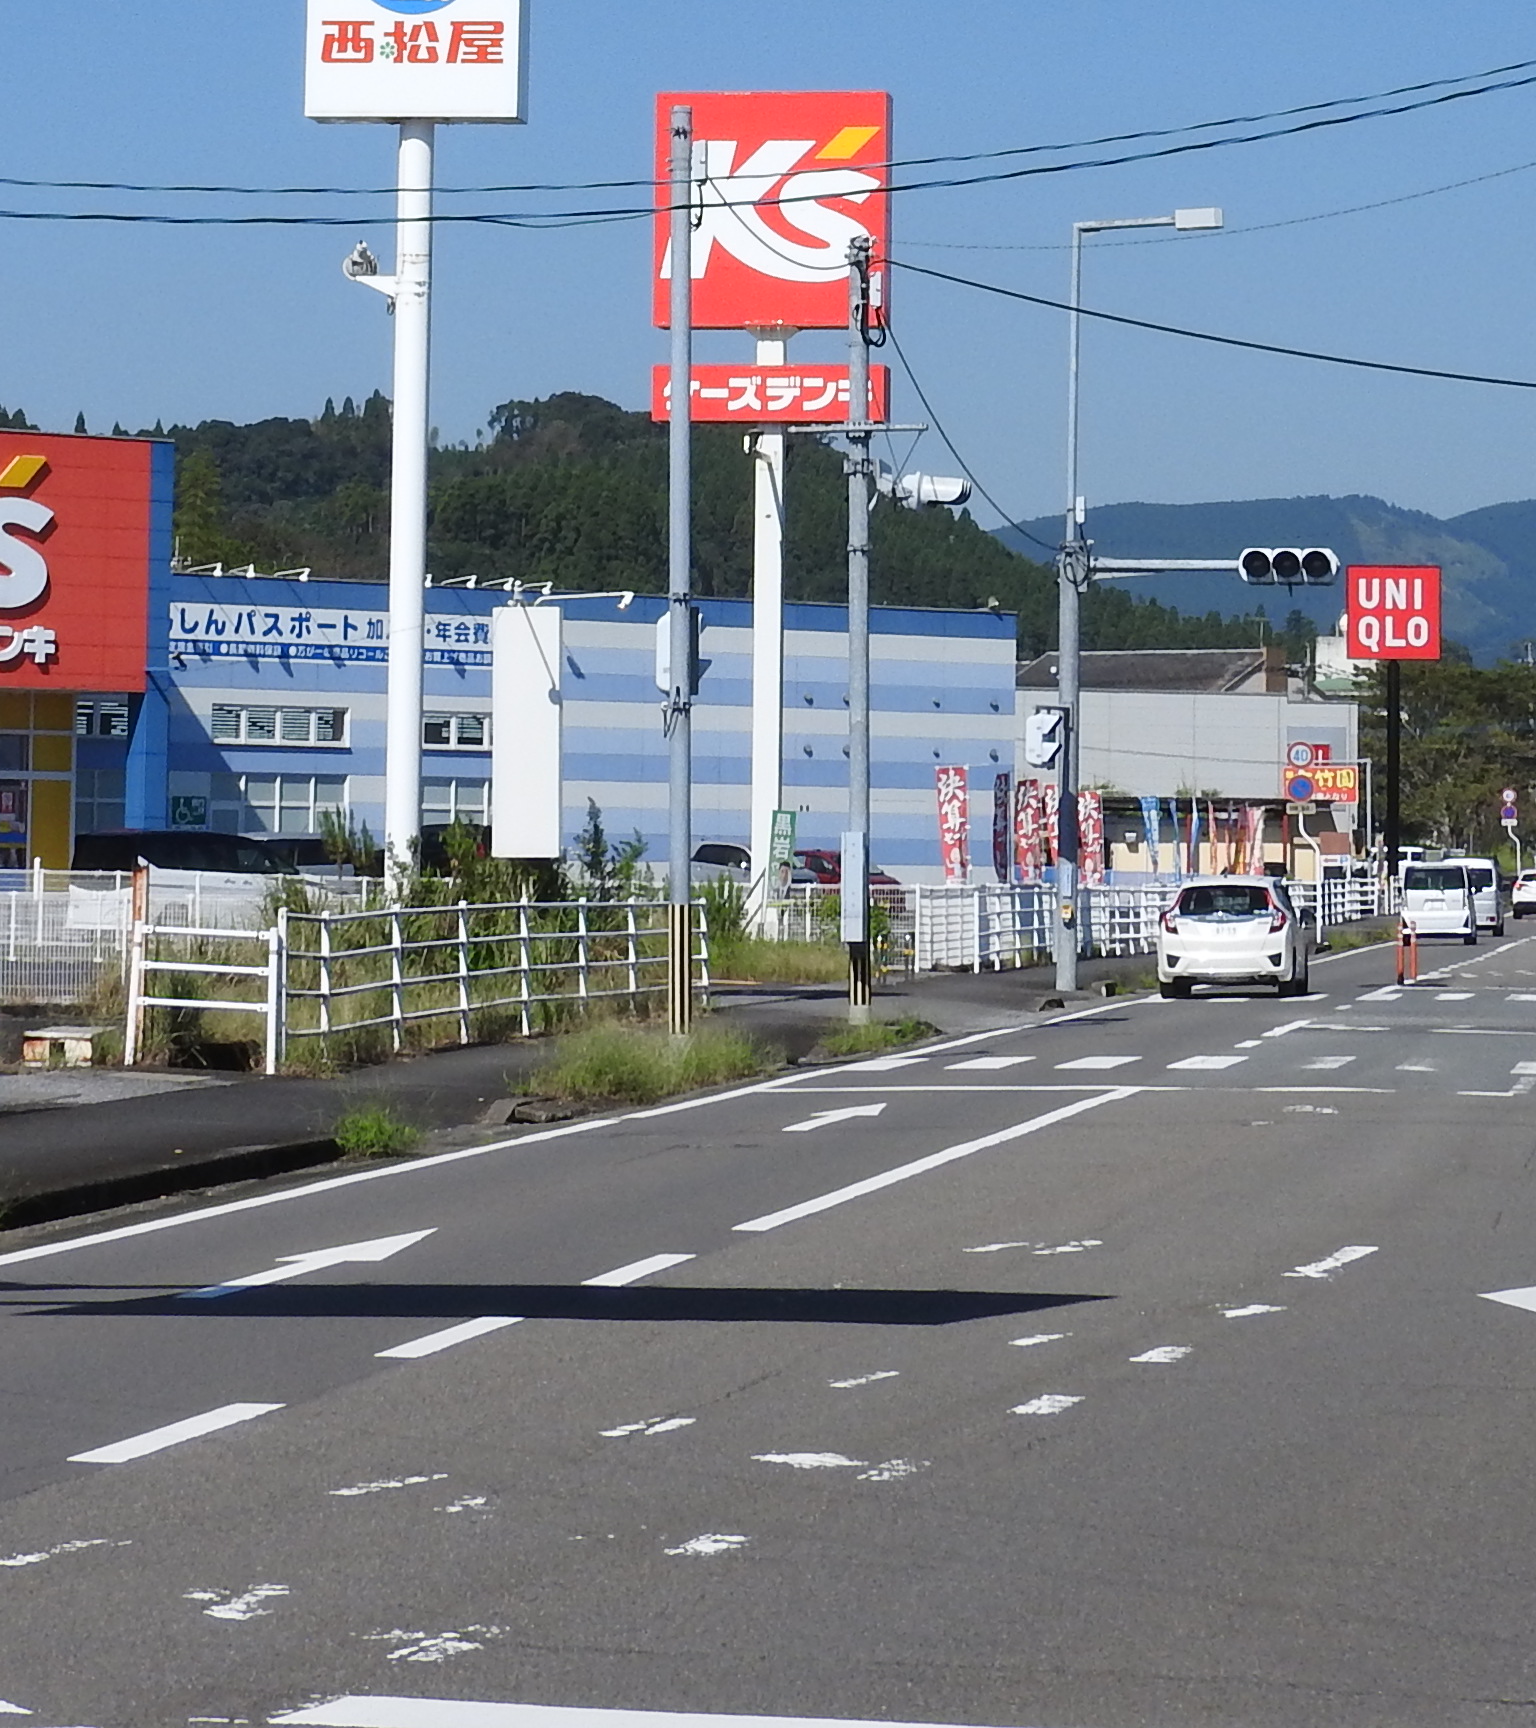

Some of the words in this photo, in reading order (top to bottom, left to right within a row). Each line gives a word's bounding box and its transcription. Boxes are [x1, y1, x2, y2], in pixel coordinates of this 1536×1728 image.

[321, 20, 505, 64] 西松屋
[1358, 578, 1422, 610] UNI
[168, 607, 359, 642] しんパスポート
[1358, 615, 1429, 652] QLO
